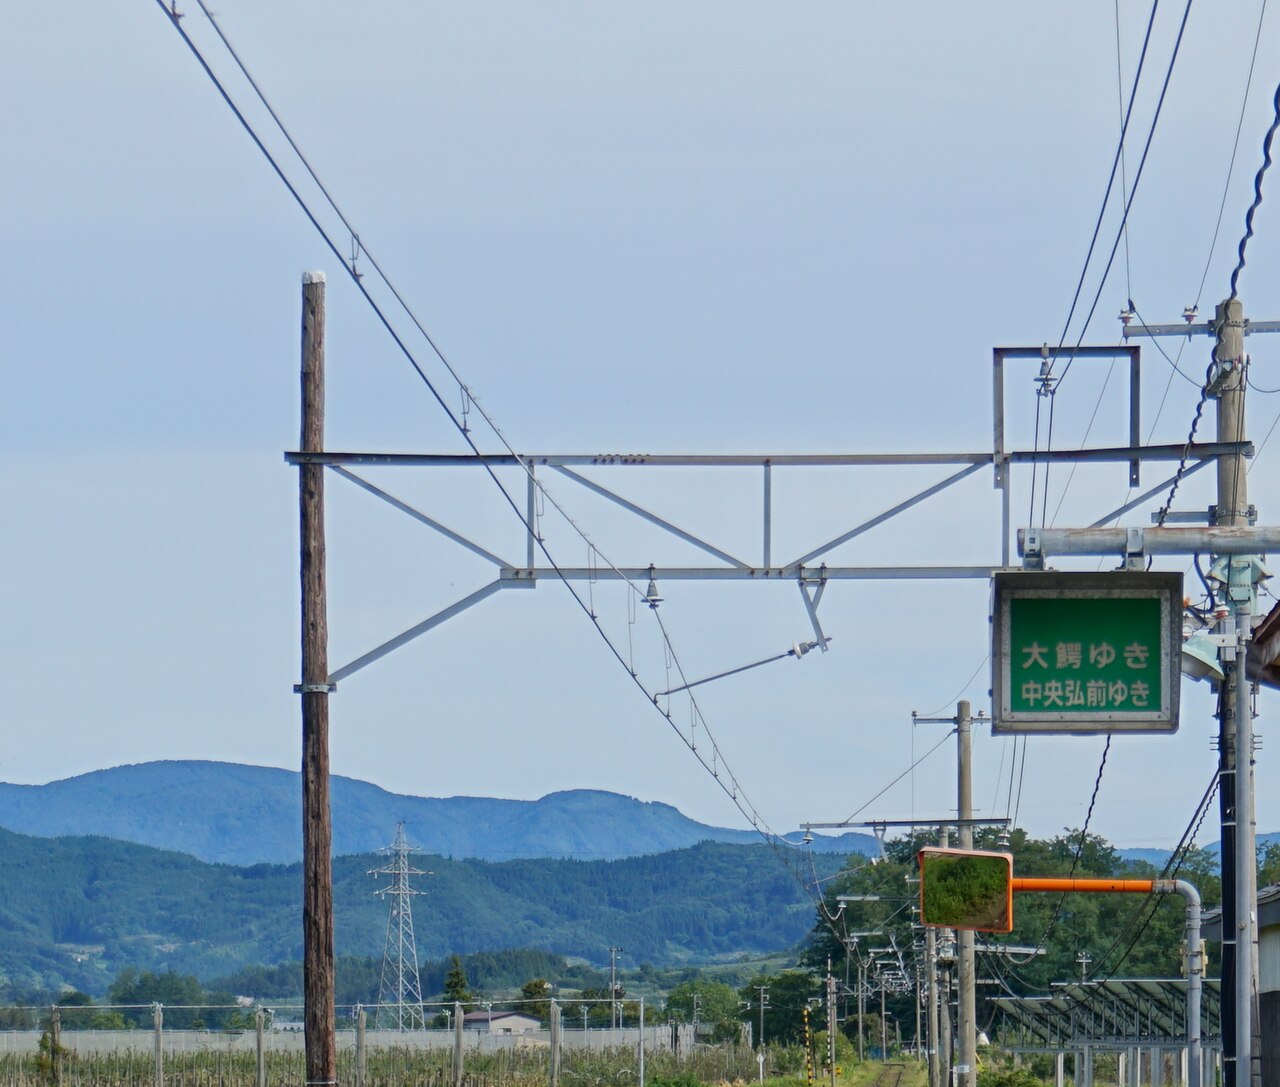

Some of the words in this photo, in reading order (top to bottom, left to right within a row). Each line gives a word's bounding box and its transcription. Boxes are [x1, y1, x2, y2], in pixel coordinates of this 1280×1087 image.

[1022, 642, 1149, 669] 大鰐ゆき
[1022, 680, 1150, 707] 中央弘前ゆき
